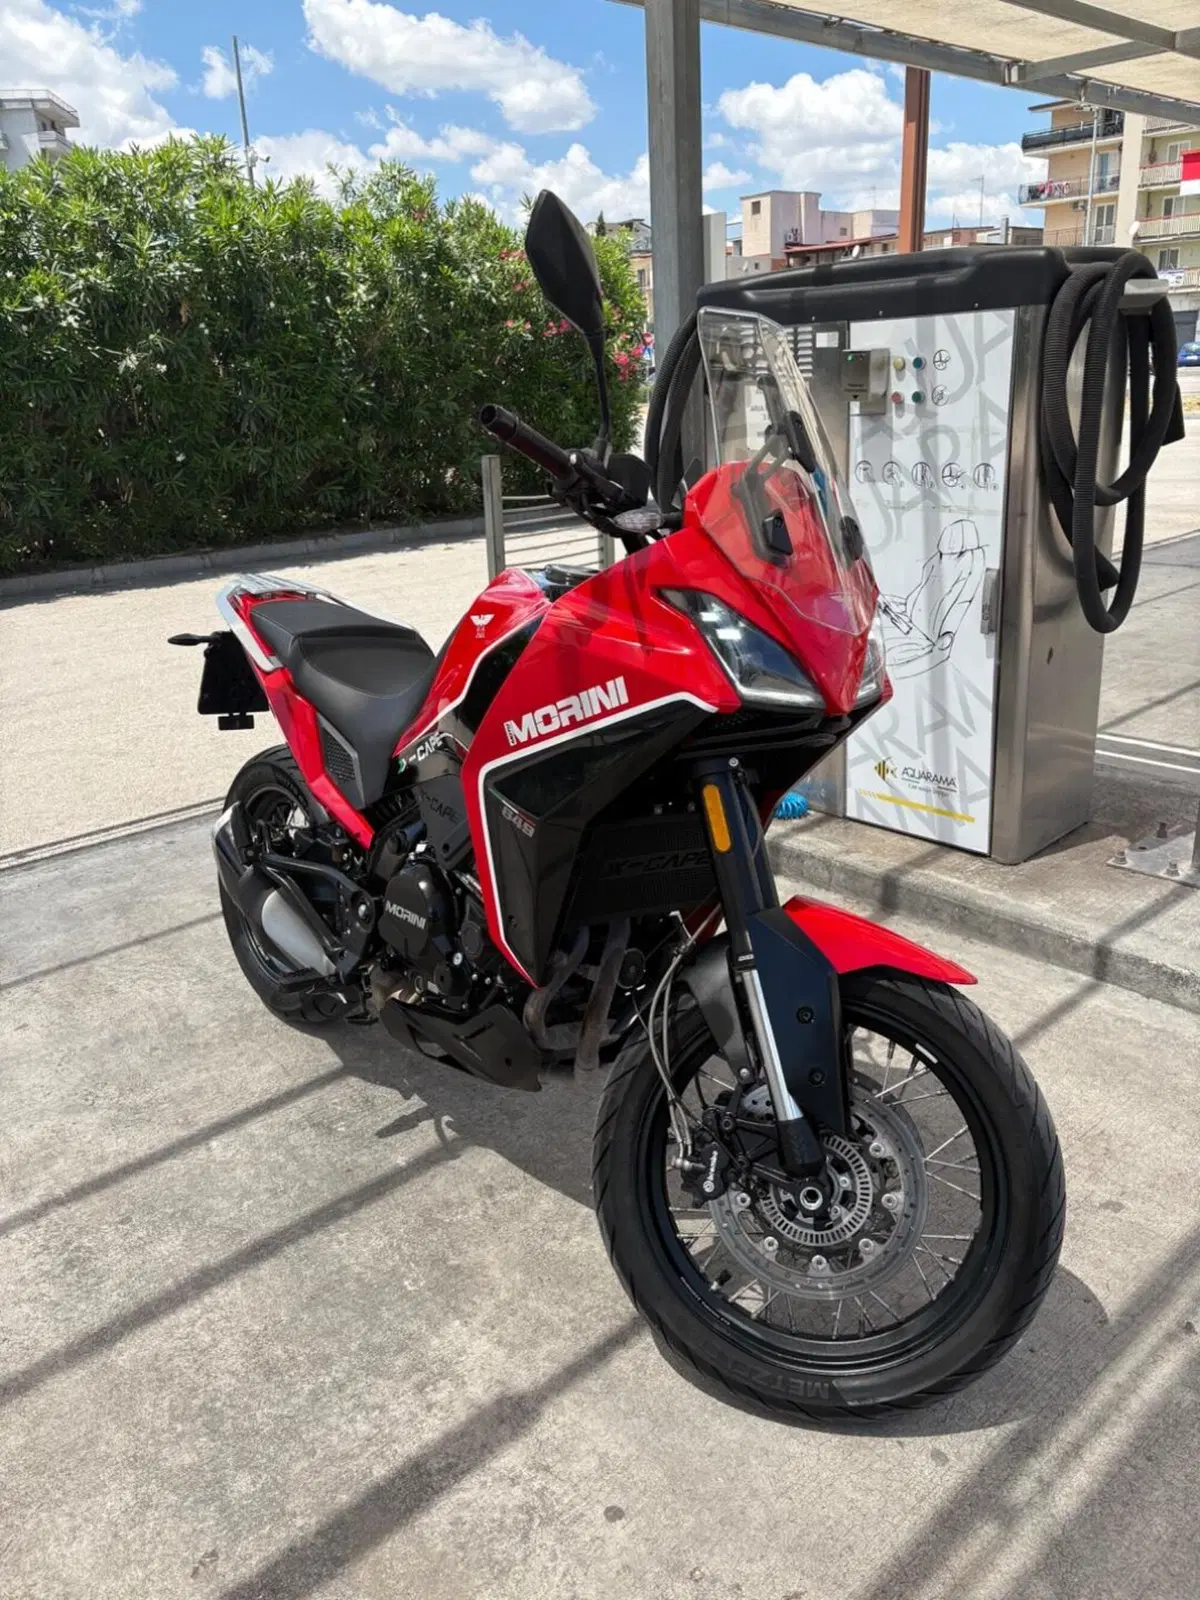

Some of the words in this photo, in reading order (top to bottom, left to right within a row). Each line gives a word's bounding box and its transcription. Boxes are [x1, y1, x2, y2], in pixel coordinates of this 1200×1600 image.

[510, 674, 629, 743] MORINI
[901, 766, 957, 788] AQUARAMA
[385, 900, 426, 930] MORINI
